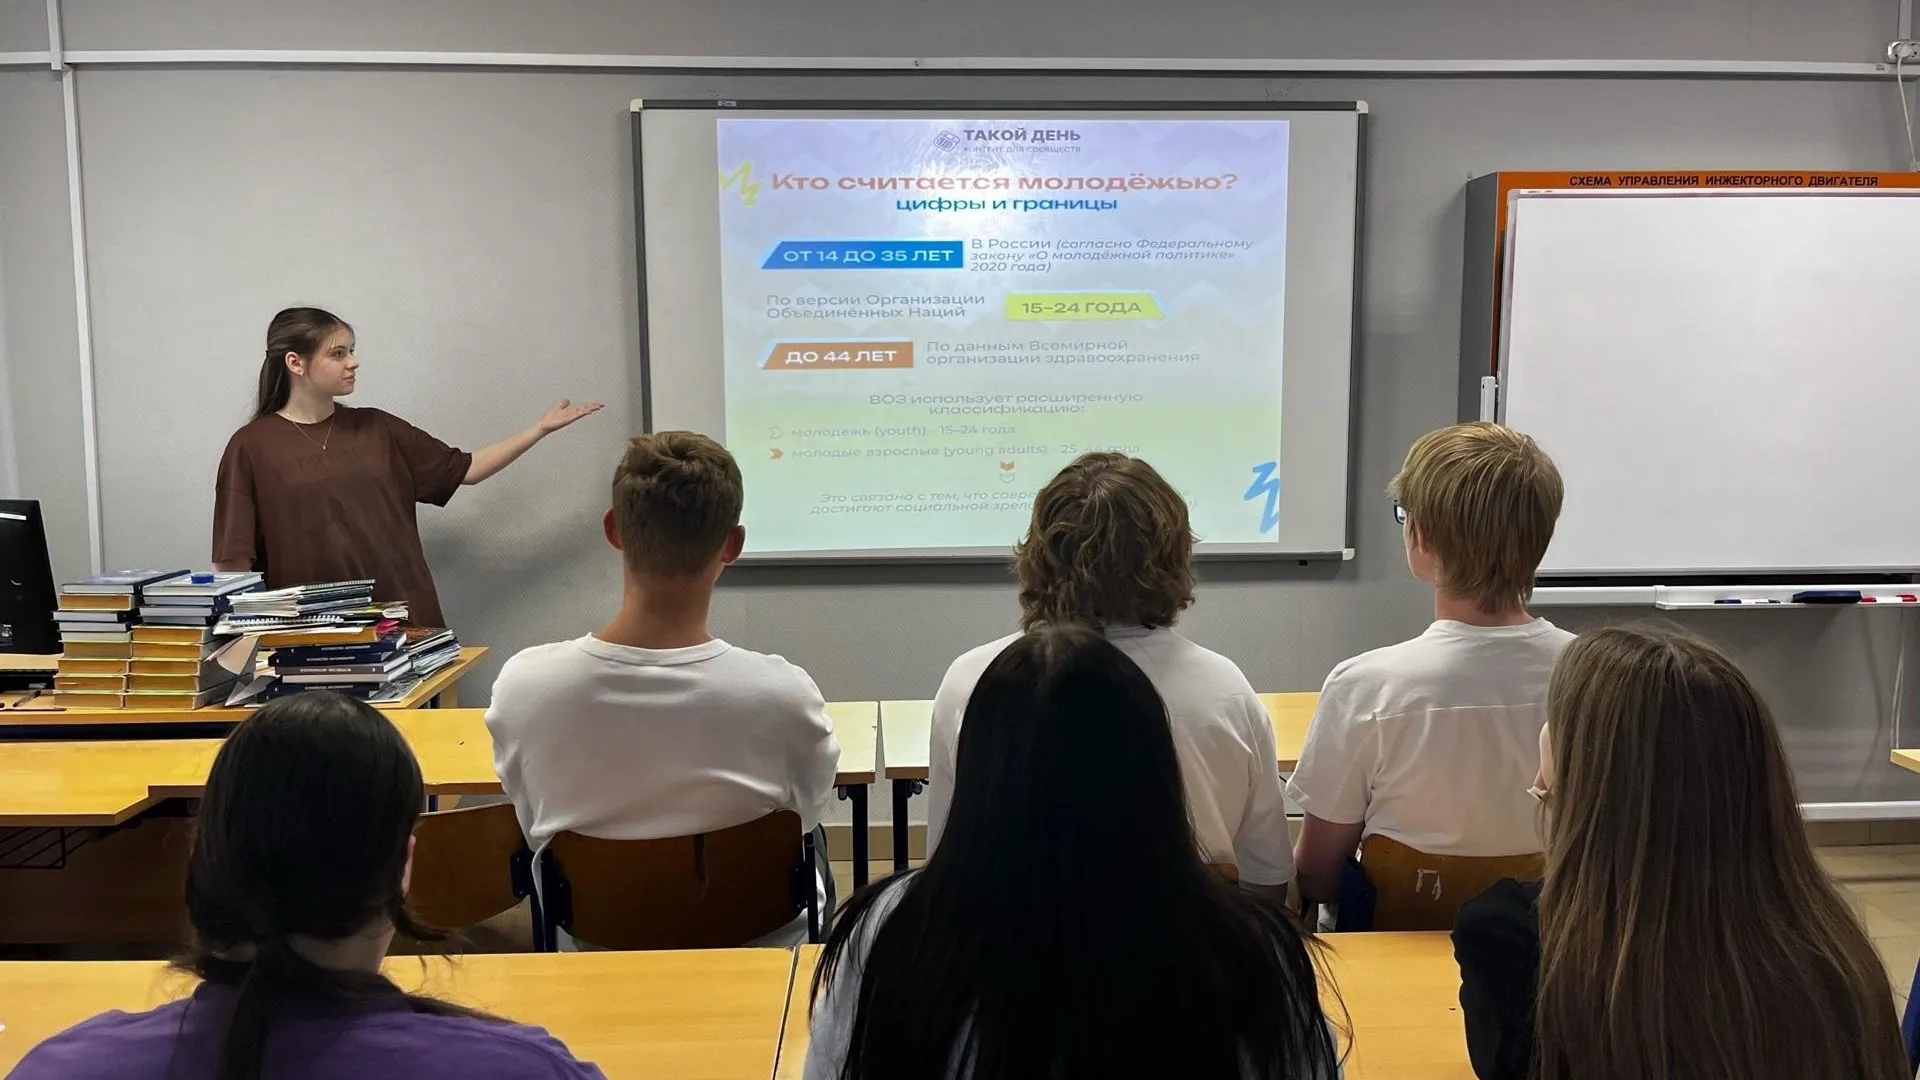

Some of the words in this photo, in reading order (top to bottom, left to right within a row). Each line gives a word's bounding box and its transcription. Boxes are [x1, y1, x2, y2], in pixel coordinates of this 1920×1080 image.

[963, 127, 1027, 141] ТАКОЙ
[1031, 129, 1081, 143] ДЕНЬ
[771, 173, 830, 190] Кто
[837, 175, 1010, 190] считается
[1018, 172, 1239, 192] молодёжью?
[1569, 176, 1612, 186] СХЕМА
[1618, 175, 1700, 187] УПРАВЛЕНИЯ
[1705, 176, 1804, 187] ИНЖЕКТОРНОГО
[1808, 176, 1879, 188] ДВИГАТЕЛЯ
[896, 197, 986, 212] цифры
[992, 199, 1007, 210] и
[1013, 199, 1118, 212] границы
[971, 238, 983, 249] В
[988, 238, 1051, 250] России
[1056, 239, 1133, 251] (согласно
[1136, 238, 1254, 251] Федеральному
[783, 250, 812, 262] ОТ
[813, 250, 839, 262] 14
[843, 250, 876, 263] ДО
[880, 250, 908, 262] 35
[911, 249, 955, 262] ЛЕТ
[970, 252, 1028, 262] закону
[1052, 249, 1151, 262] молодёжной
[1155, 251, 1236, 261] политике»
[970, 262, 1007, 272] 2020
[1010, 262, 1051, 273] года)
[766, 294, 791, 307] По
[796, 296, 861, 308] версии
[865, 293, 986, 307] Организации
[766, 307, 901, 320] Объединённых
[908, 306, 966, 319] Наций
[1085, 302, 1142, 315] ГОДА
[926, 341, 951, 353] По
[955, 342, 1024, 353] данным
[1029, 340, 1129, 352] Всемирной
[785, 351, 818, 364] ДО
[823, 351, 852, 362] 44
[855, 350, 898, 362] ЛЕТ
[926, 355, 1041, 366] организации
[1045, 353, 1200, 365] здравоохранения
[869, 394, 907, 405] ВОЗ
[911, 394, 1013, 405] использует
[1016, 392, 1144, 404] расширенную
[929, 403, 1085, 415] классификацию:
[875, 425, 927, 438] (youth)
[982, 426, 1015, 436] года
[791, 448, 862, 459] молодые
[866, 447, 939, 458] взрослые
[944, 445, 994, 457] (young
[998, 445, 1048, 456] adults)
[820, 493, 847, 503] Это
[851, 493, 914, 503] связано
[917, 493, 925, 501] с
[929, 492, 960, 502] тем,
[964, 491, 989, 500] что
[808, 503, 893, 515] достигают
[895, 501, 988, 513] социальной
